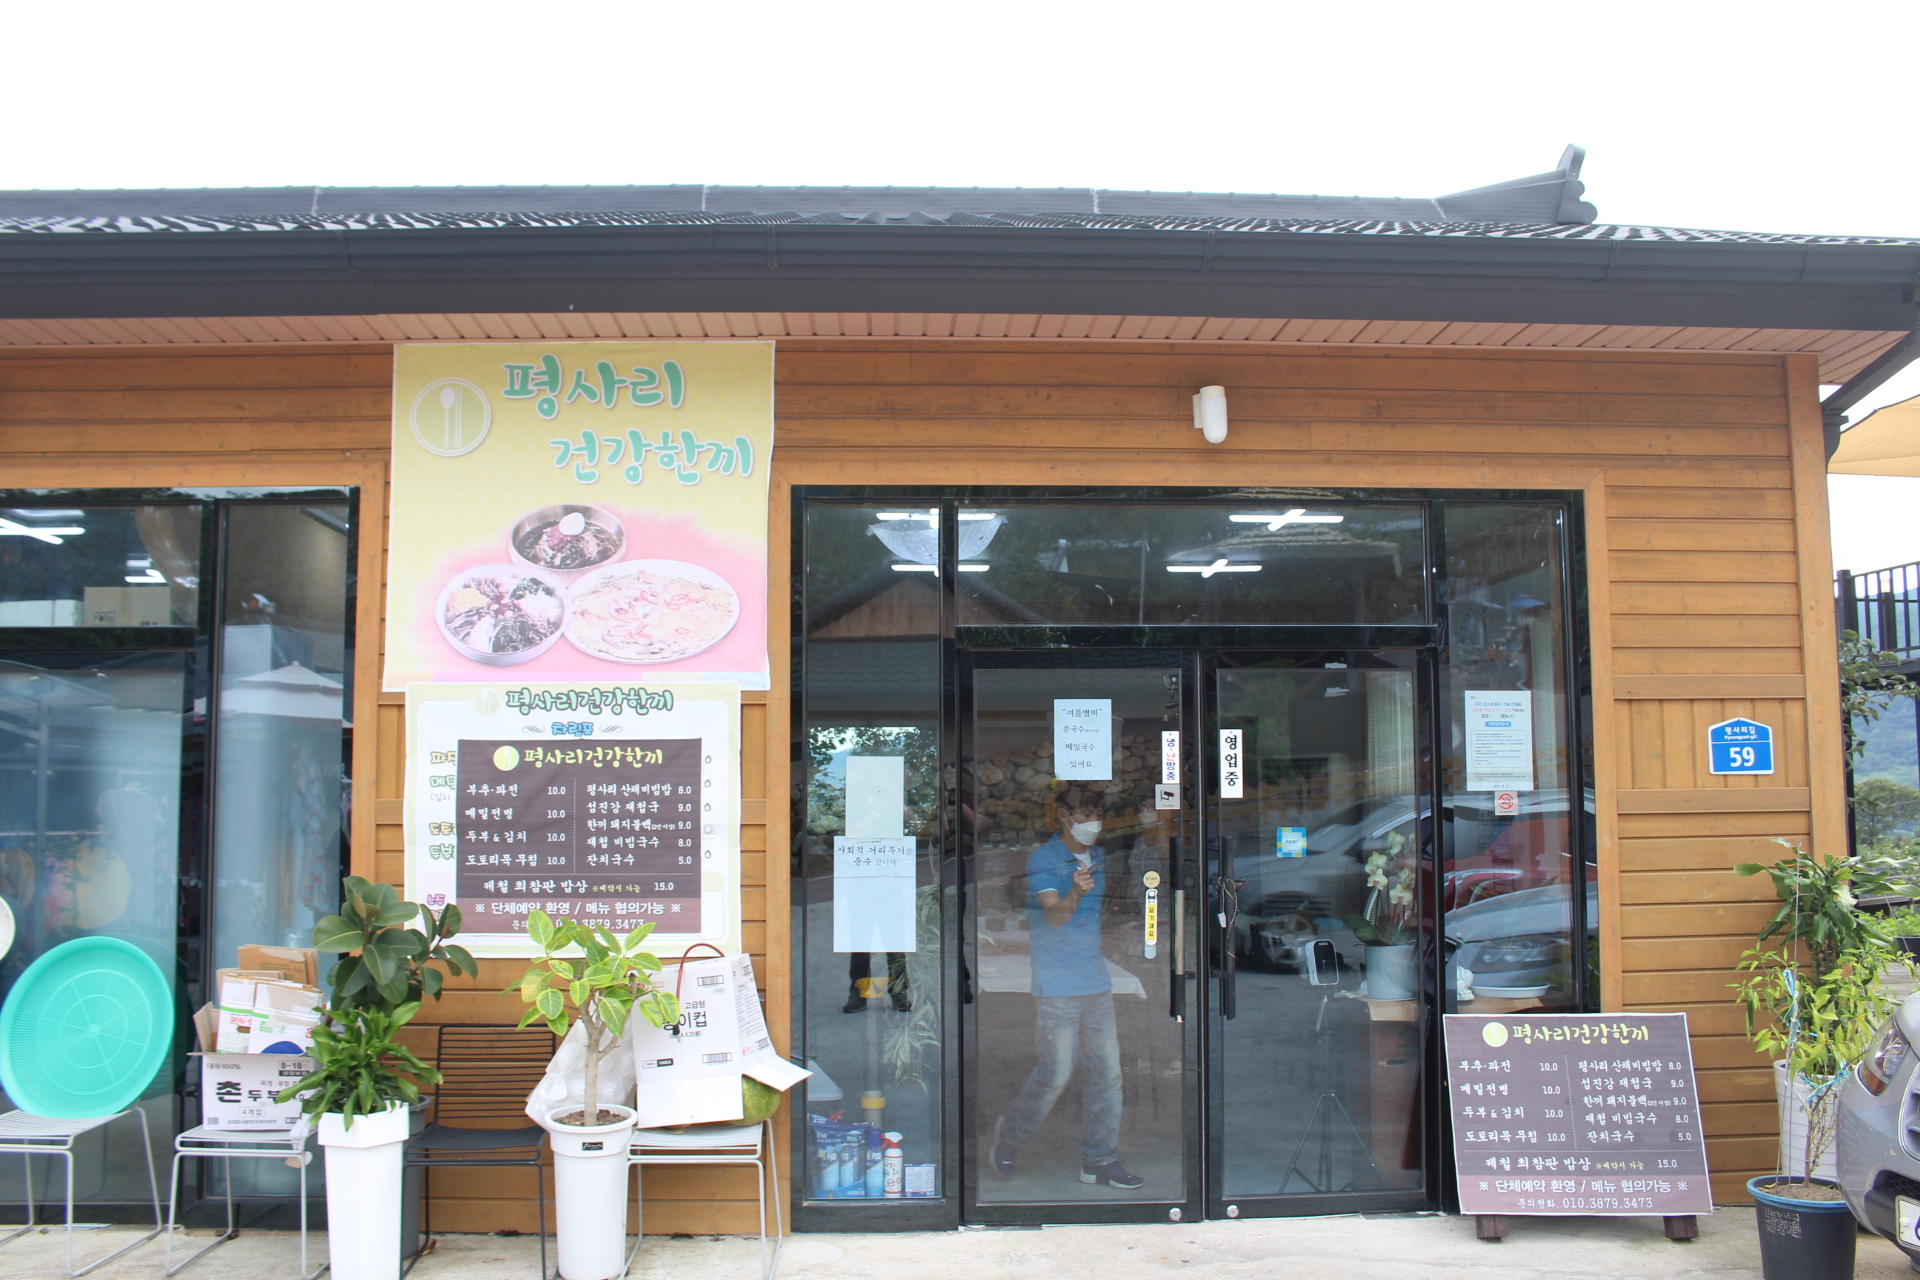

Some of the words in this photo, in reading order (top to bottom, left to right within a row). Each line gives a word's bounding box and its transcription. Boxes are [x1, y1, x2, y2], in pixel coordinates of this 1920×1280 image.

[502, 354, 685, 418] 평사리
[550, 429, 753, 485] 건강한끼
[506, 687, 674, 715] 평사리건강한끼
[551, 721, 594, 736] 차림표
[1725, 726, 1756, 735] 평사리길
[1065, 743, 1096, 751] 메밀국수
[524, 747, 662, 768] 평사리건강한끼
[1225, 735, 1238, 787] 영업중
[1730, 747, 1755, 767] 59
[587, 784, 616, 796] 평사리
[621, 784, 672, 796] 산채비빔밥
[678, 786, 691, 794] 8.0
[587, 801, 621, 813] 섬진강
[625, 801, 659, 813] 재첩국
[465, 807, 512, 820] 메밀전병
[548, 810, 565, 818] 10.0
[587, 819, 606, 831] 한끼
[610, 819, 653, 831] 돼지불백
[678, 821, 691, 829] 9.0
[466, 831, 489, 842] 두부
[493, 834, 499, 842] &
[504, 831, 526, 843] 김치
[548, 833, 565, 841] 10.0
[587, 836, 607, 848] 재첩
[614, 836, 659, 848] 비빔국수
[678, 839, 691, 847] 8.0
[838, 846, 864, 855] 사회적
[466, 854, 512, 866] 도토리묵
[515, 854, 537, 866] 무침
[548, 857, 565, 865] 10.0
[587, 854, 634, 866] 잔치국수
[679, 856, 691, 864] 5.0
[853, 857, 872, 866] 준수
[484, 880, 508, 893] 제철
[514, 880, 556, 893] 최참판
[561, 880, 588, 893] 밥상
[655, 882, 674, 890] 15.0
[545, 902, 570, 914] 환영
[586, 902, 610, 914] 메뉴
[615, 902, 664, 914] 협의가능
[1513, 1024, 1648, 1044] 평사리건강한끼
[1540, 1063, 1557, 1071] 10.0
[1579, 1060, 1607, 1072] 평사리
[1612, 1060, 1662, 1072] 산채비빔밥
[1669, 1062, 1681, 1070] 8.0
[1460, 1083, 1508, 1096] 메밀전병
[1543, 1086, 1560, 1094] 10.0
[1581, 1078, 1614, 1090] 섬진강
[1619, 1077, 1652, 1089] 재첩국
[1671, 1079, 1684, 1087] 9.0
[1583, 1095, 1602, 1107] 한끼
[1607, 1095, 1649, 1107] 돼지불백
[1674, 1097, 1686, 1105] 9.0
[1463, 1107, 1486, 1118] 두부
[1491, 1109, 1497, 1118] &
[1502, 1106, 1523, 1119] 김치
[1545, 1109, 1563, 1117] 10.0
[1585, 1113, 1605, 1125] 재첩
[1612, 1112, 1656, 1124] 비빔국수
[1676, 1115, 1688, 1123] 8.0
[1465, 1130, 1511, 1143] 도토리묵
[1515, 1130, 1536, 1143] 무침
[1548, 1133, 1565, 1141] 10.0
[1587, 1131, 1634, 1143] 잔치국수
[1485, 1157, 1510, 1171] 제철
[1517, 1157, 1558, 1170] 최참판
[1563, 1157, 1591, 1170] 밥상
[1658, 1159, 1677, 1167] 15.0
[1496, 1180, 1546, 1192] 단체예약
[1551, 1180, 1575, 1192] 환영
[1592, 1180, 1616, 1192] 메뉴
[1621, 1180, 1671, 1192] 협의가능
[1563, 1198, 1652, 1208] 010.3879.3473
